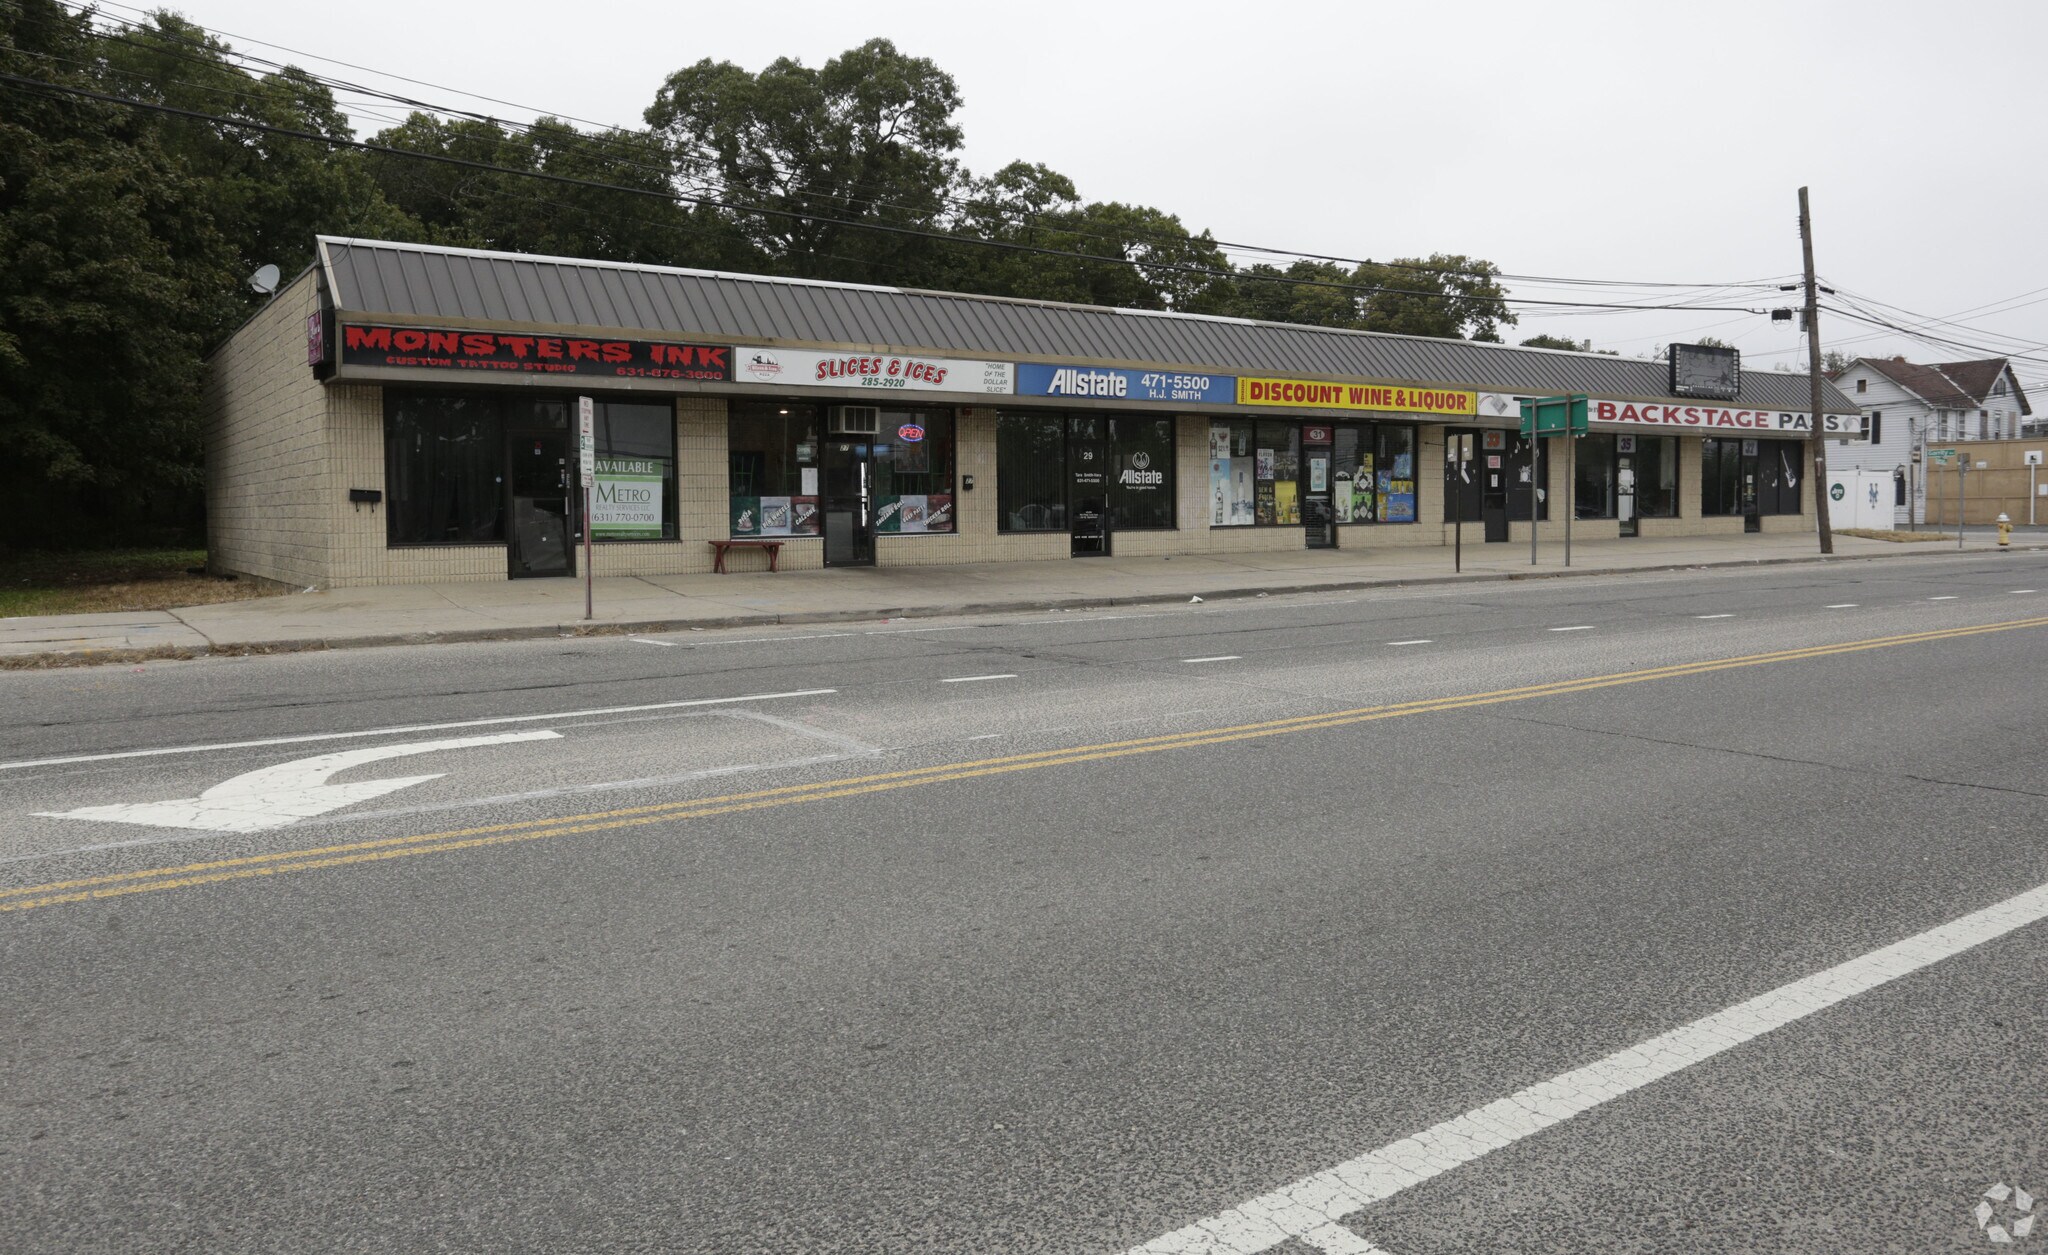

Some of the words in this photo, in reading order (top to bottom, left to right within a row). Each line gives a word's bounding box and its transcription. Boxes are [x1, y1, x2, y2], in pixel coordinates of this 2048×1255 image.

[345, 326, 633, 363] MONSTERS
[651, 345, 729, 369] INK
[386, 356, 451, 366] CUSTOM
[816, 357, 883, 380] SLICES
[886, 359, 902, 377] &
[903, 360, 948, 385] ICES
[861, 377, 905, 387] 285-2920
[1047, 369, 1127, 397] Allstate
[1141, 374, 1210, 390] 471-5500
[1150, 390, 1167, 398] H.J.
[1172, 390, 1201, 400] SMITH
[1250, 382, 1343, 404] DISCOUNT
[1349, 387, 1392, 406] WINE
[1395, 390, 1406, 407] &
[1409, 391, 1467, 410] LIQUOR
[1597, 402, 1769, 429] BACKSTAGE
[1778, 413, 1839, 431] PAS
[899, 428, 924, 438] OPEN
[1621, 438, 1632, 450] 35
[1083, 452, 1093, 460] 29
[595, 461, 653, 473] AVAILABLE
[1119, 470, 1162, 484] Allstate
[592, 513, 612, 522] (631)
[615, 514, 654, 522] 770-0700
[795, 507, 816, 525] CALZONE
